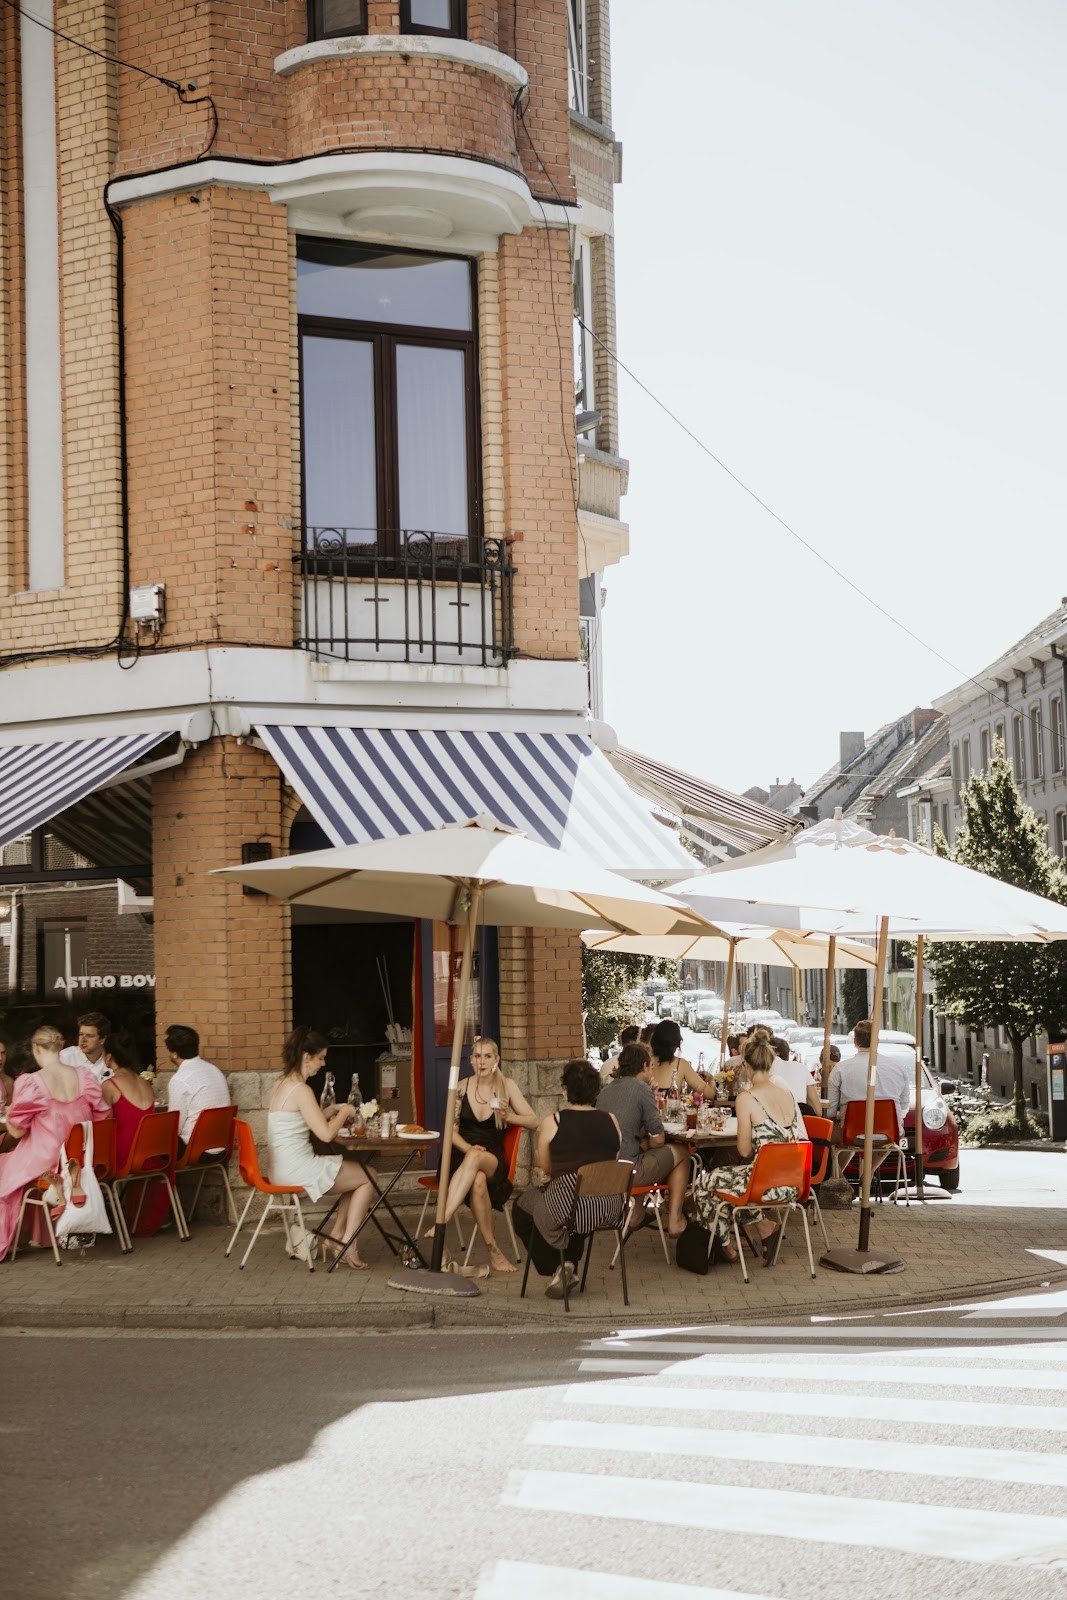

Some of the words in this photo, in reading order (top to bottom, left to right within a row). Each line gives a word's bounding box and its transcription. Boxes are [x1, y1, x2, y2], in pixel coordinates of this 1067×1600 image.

[54, 975, 117, 989] ASTRO
[120, 974, 156, 987] BOY
[1053, 1055, 1060, 1065] P
